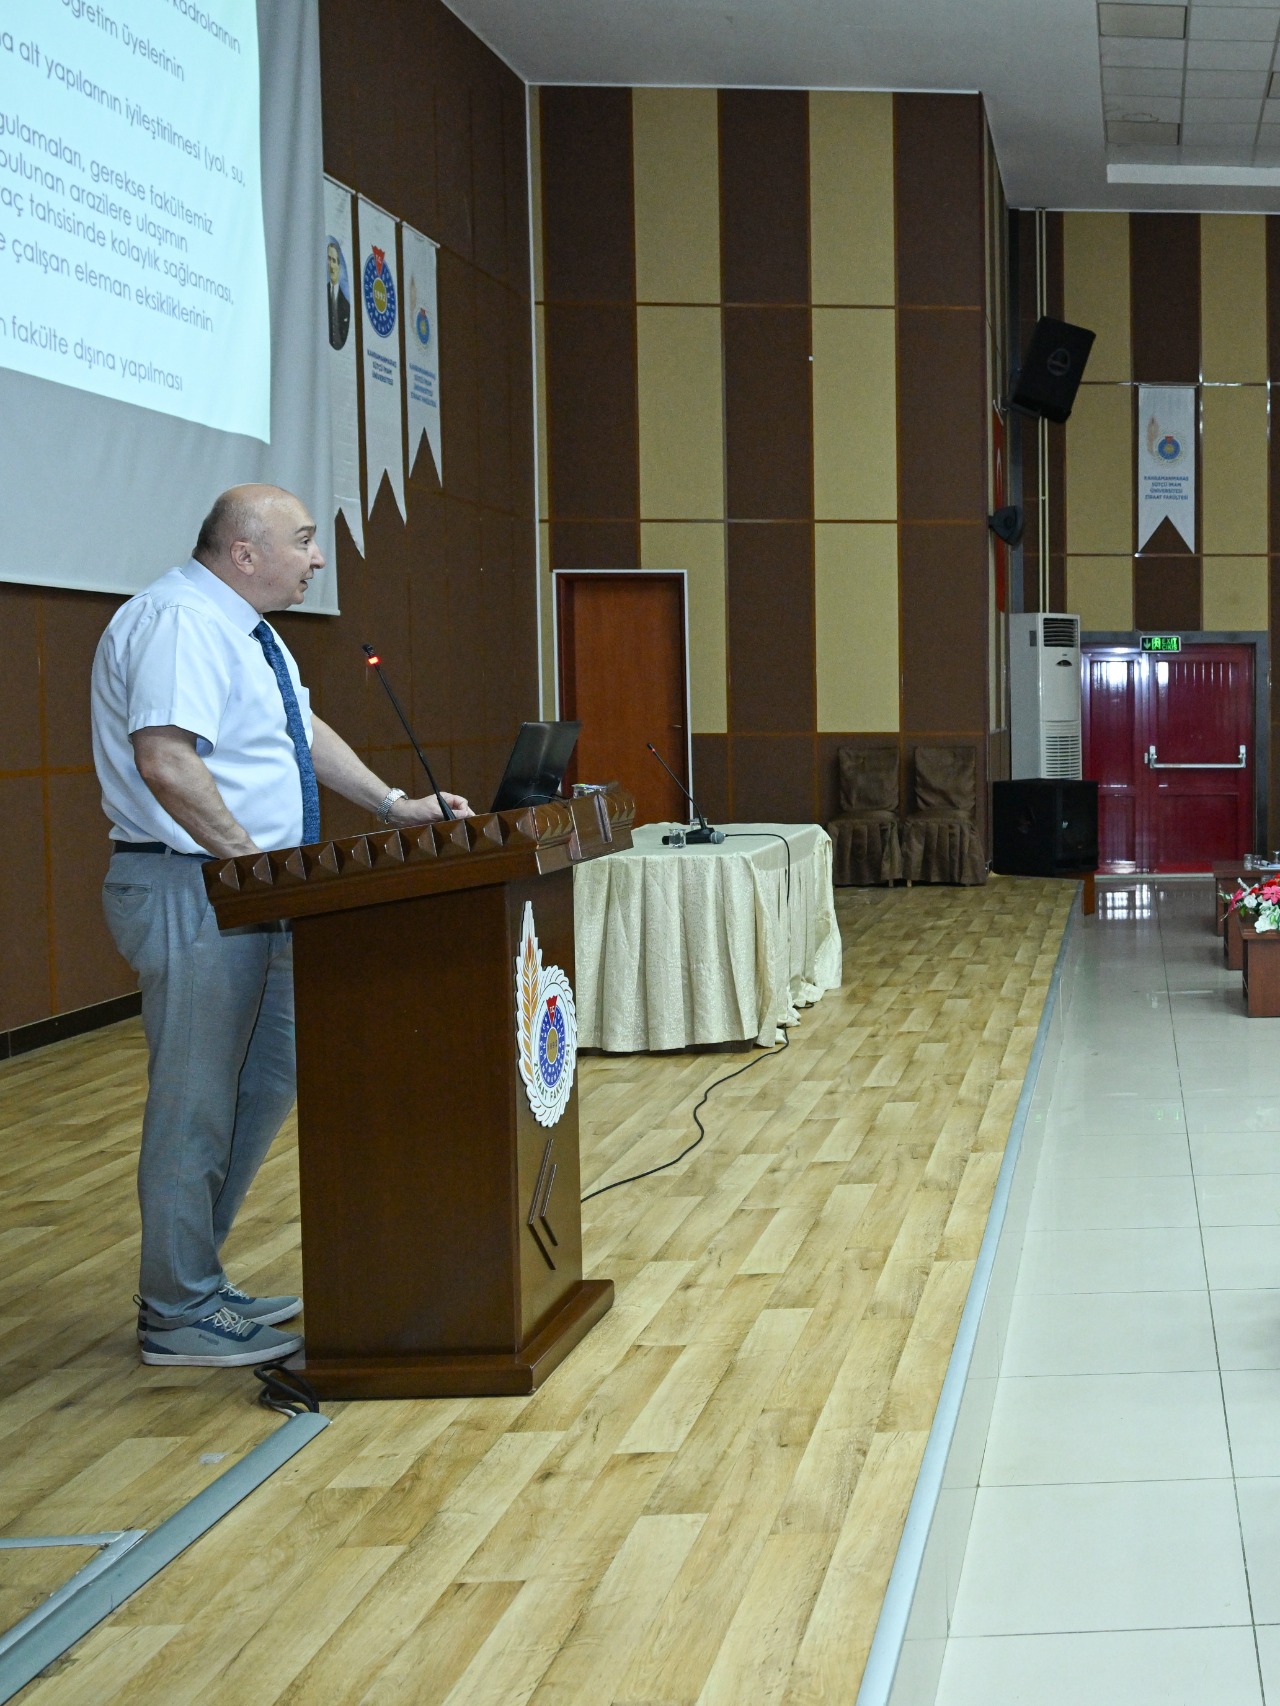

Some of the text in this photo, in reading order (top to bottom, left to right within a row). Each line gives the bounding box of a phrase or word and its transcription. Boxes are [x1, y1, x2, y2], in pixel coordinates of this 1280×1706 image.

[122, 23, 185, 82] üyelerinin
[19, 41, 40, 68] alt
[125, 98, 201, 161] iyileştirilmesi
[204, 145, 229, 178] (yol,
[70, 182, 132, 226] arazilere
[136, 213, 188, 253] ulaşımın
[90, 159, 146, 201] gerekse
[150, 184, 214, 235] fakültemiz
[12, 237, 71, 277] çalışan
[74, 261, 132, 301] eleman
[135, 285, 214, 333] eksikliklerinin
[29, 197, 106, 248] tahsisinde
[111, 229, 161, 272] kolaylık
[163, 259, 235, 305] sağlanması,
[12, 315, 69, 355] fakülte
[73, 337, 116, 370] dışına
[120, 356, 183, 391] yapılması
